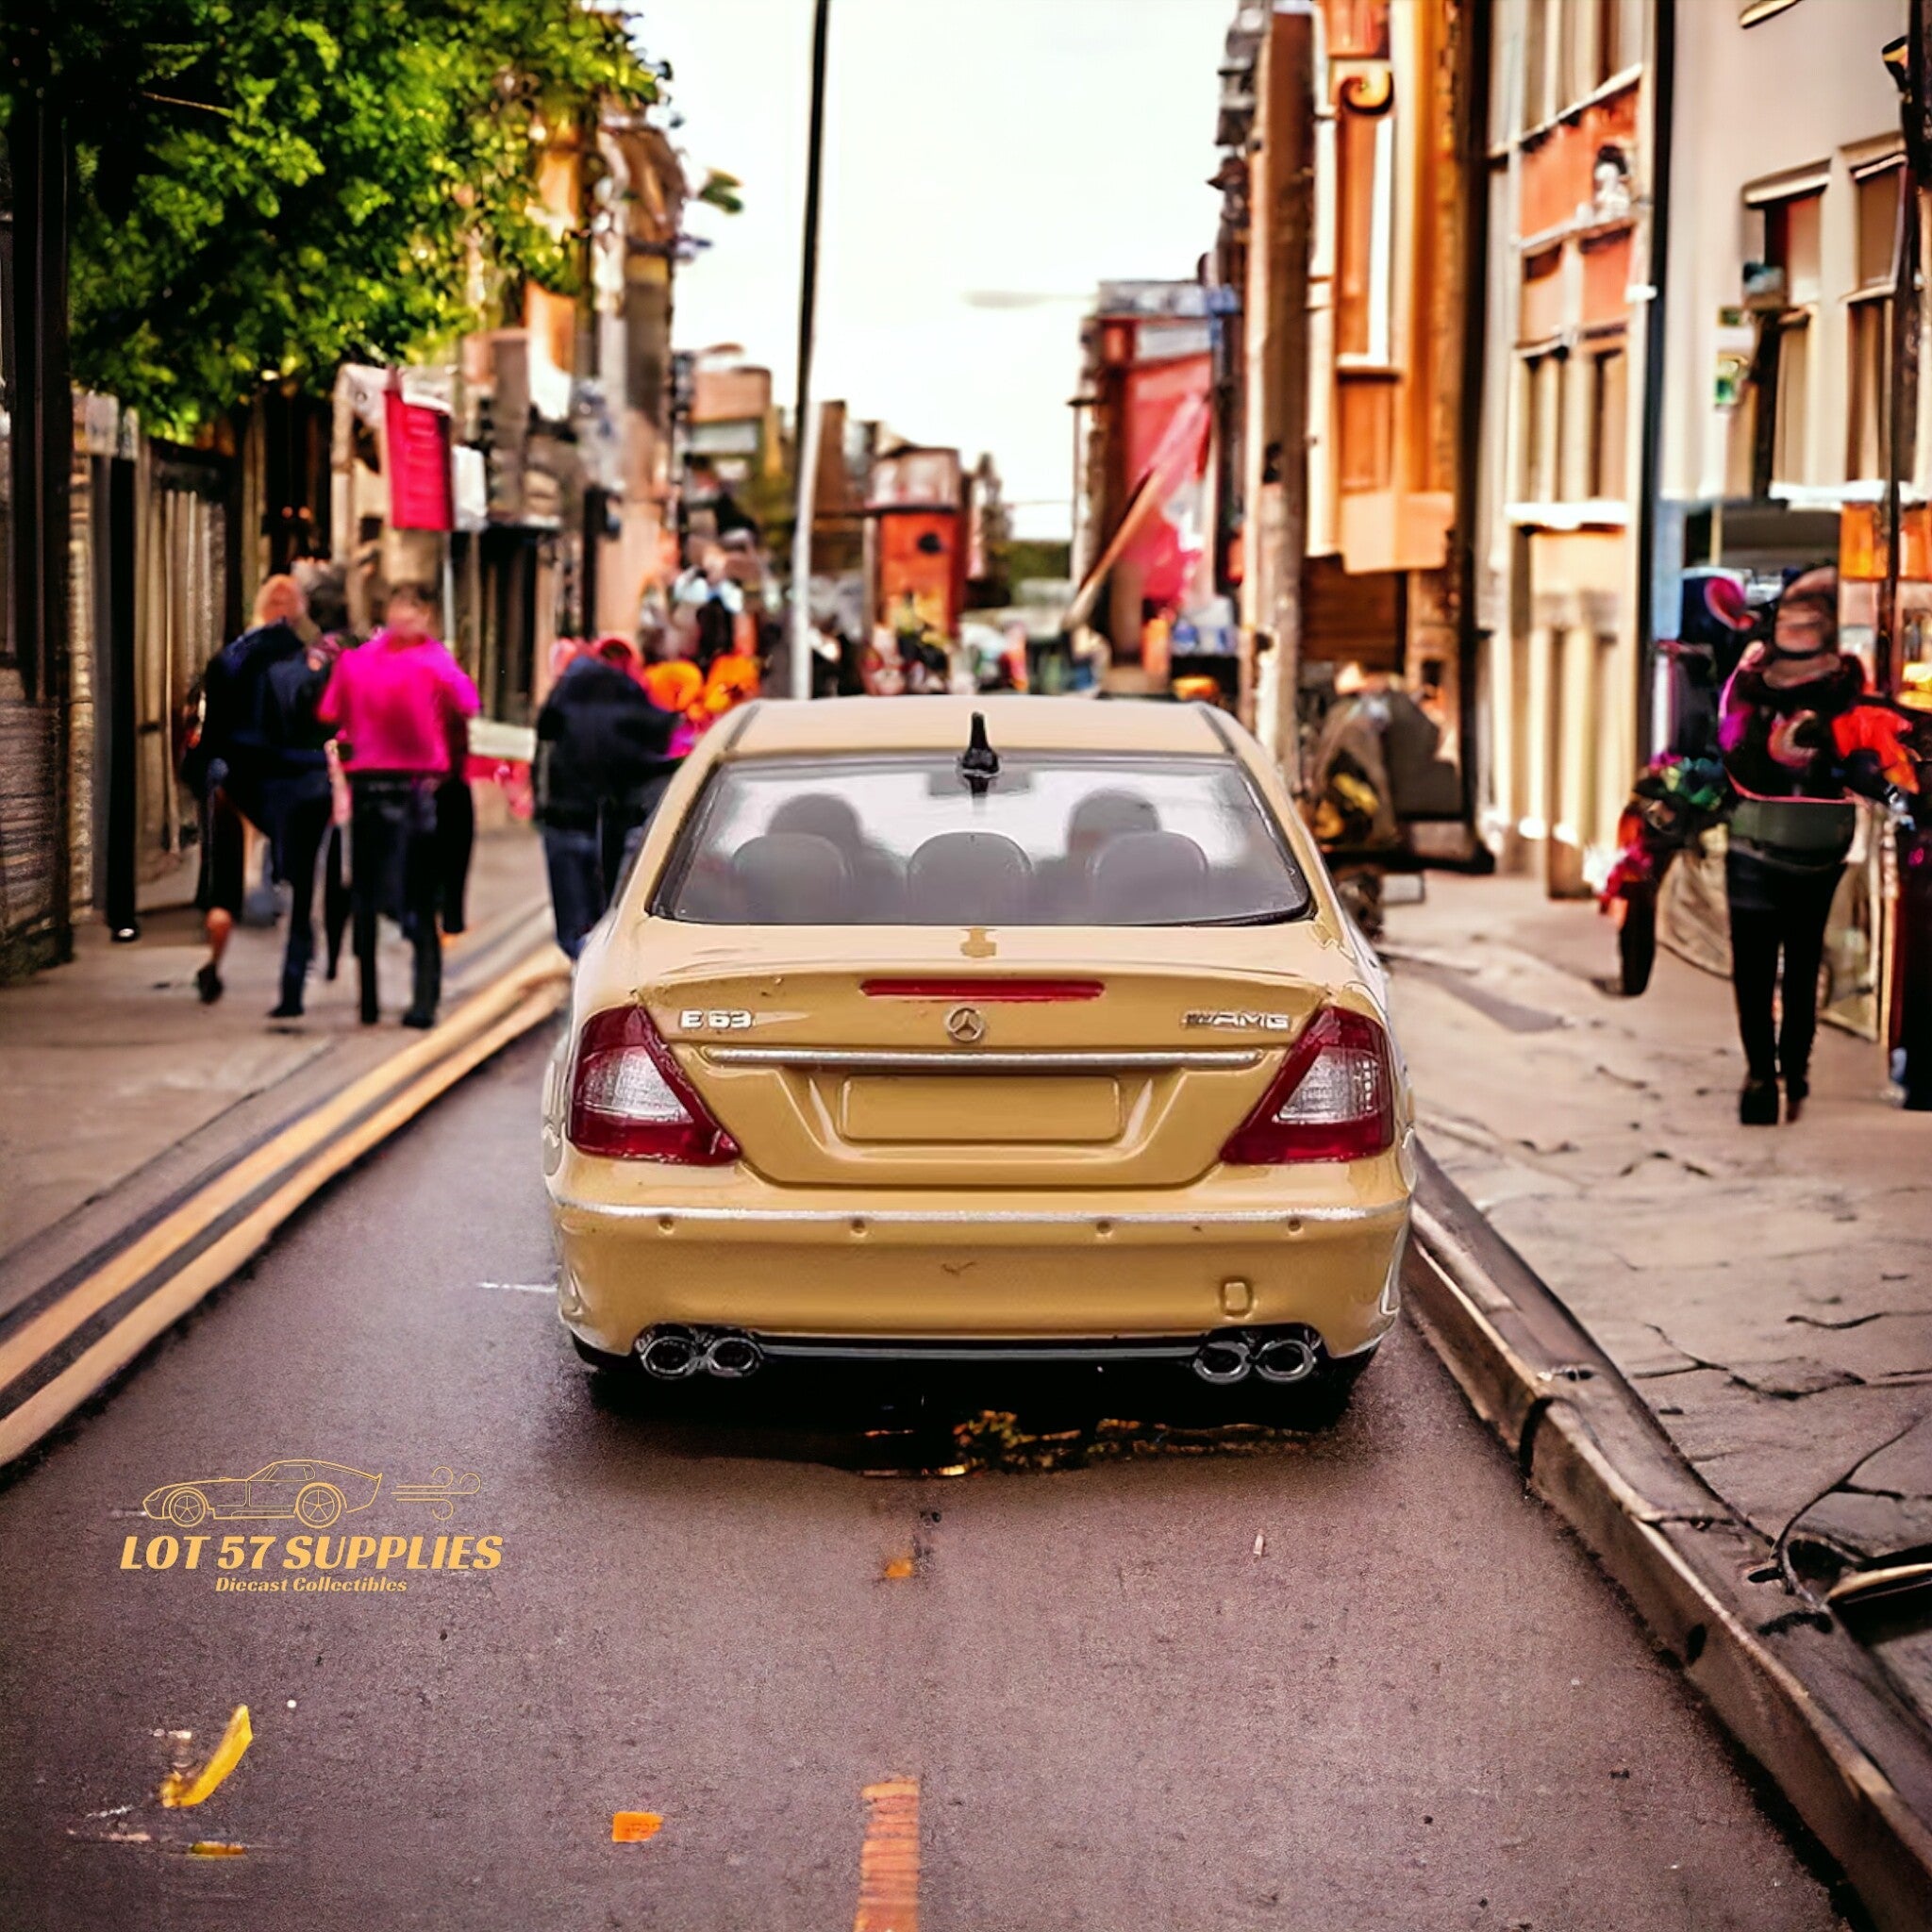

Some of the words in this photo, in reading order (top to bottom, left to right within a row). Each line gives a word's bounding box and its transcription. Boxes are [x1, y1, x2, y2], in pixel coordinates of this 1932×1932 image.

[680, 1010, 704, 1028] E
[708, 1010, 752, 1028] 63
[1211, 1011, 1290, 1030] AMG
